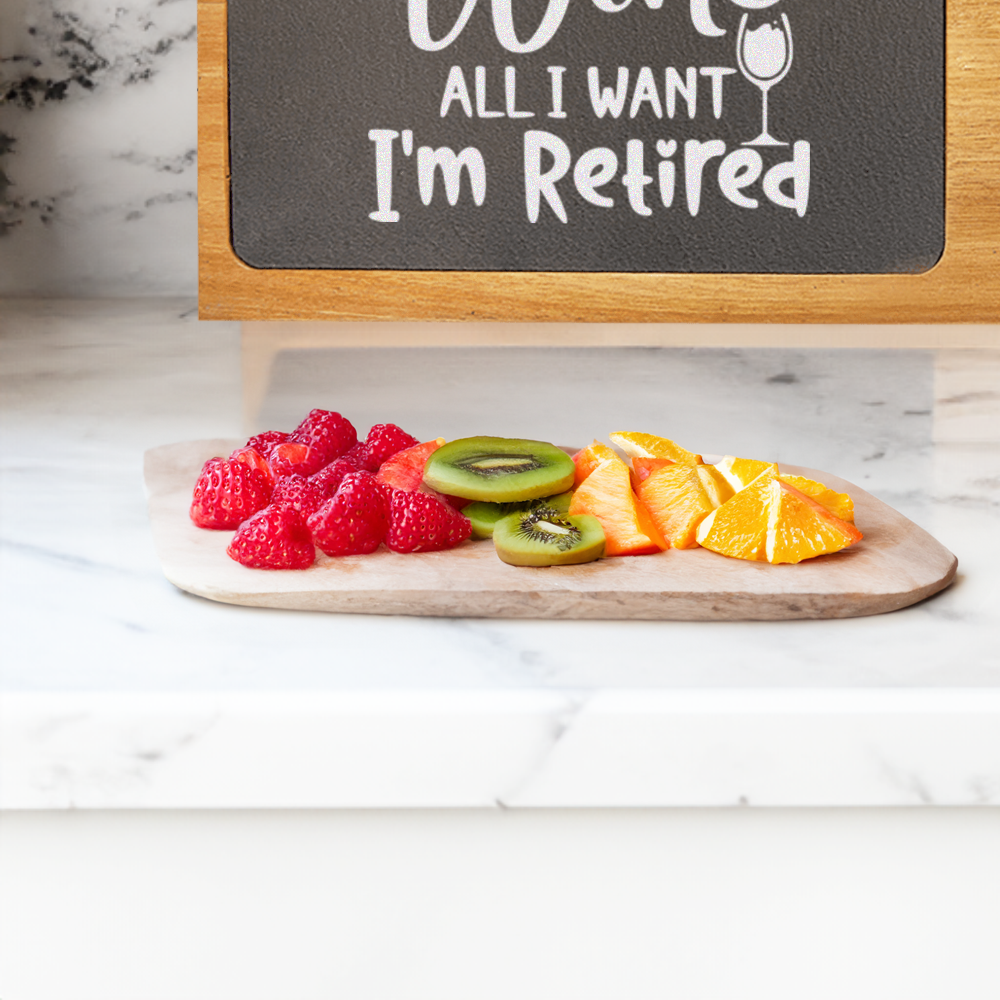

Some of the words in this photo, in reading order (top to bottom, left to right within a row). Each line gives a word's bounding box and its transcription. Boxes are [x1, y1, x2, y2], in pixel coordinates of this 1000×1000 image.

[439, 65, 536, 119] ALL
[546, 65, 568, 119] I
[586, 65, 738, 120] WANT
[367, 128, 487, 223] I'm
[523, 129, 811, 224] Retired
